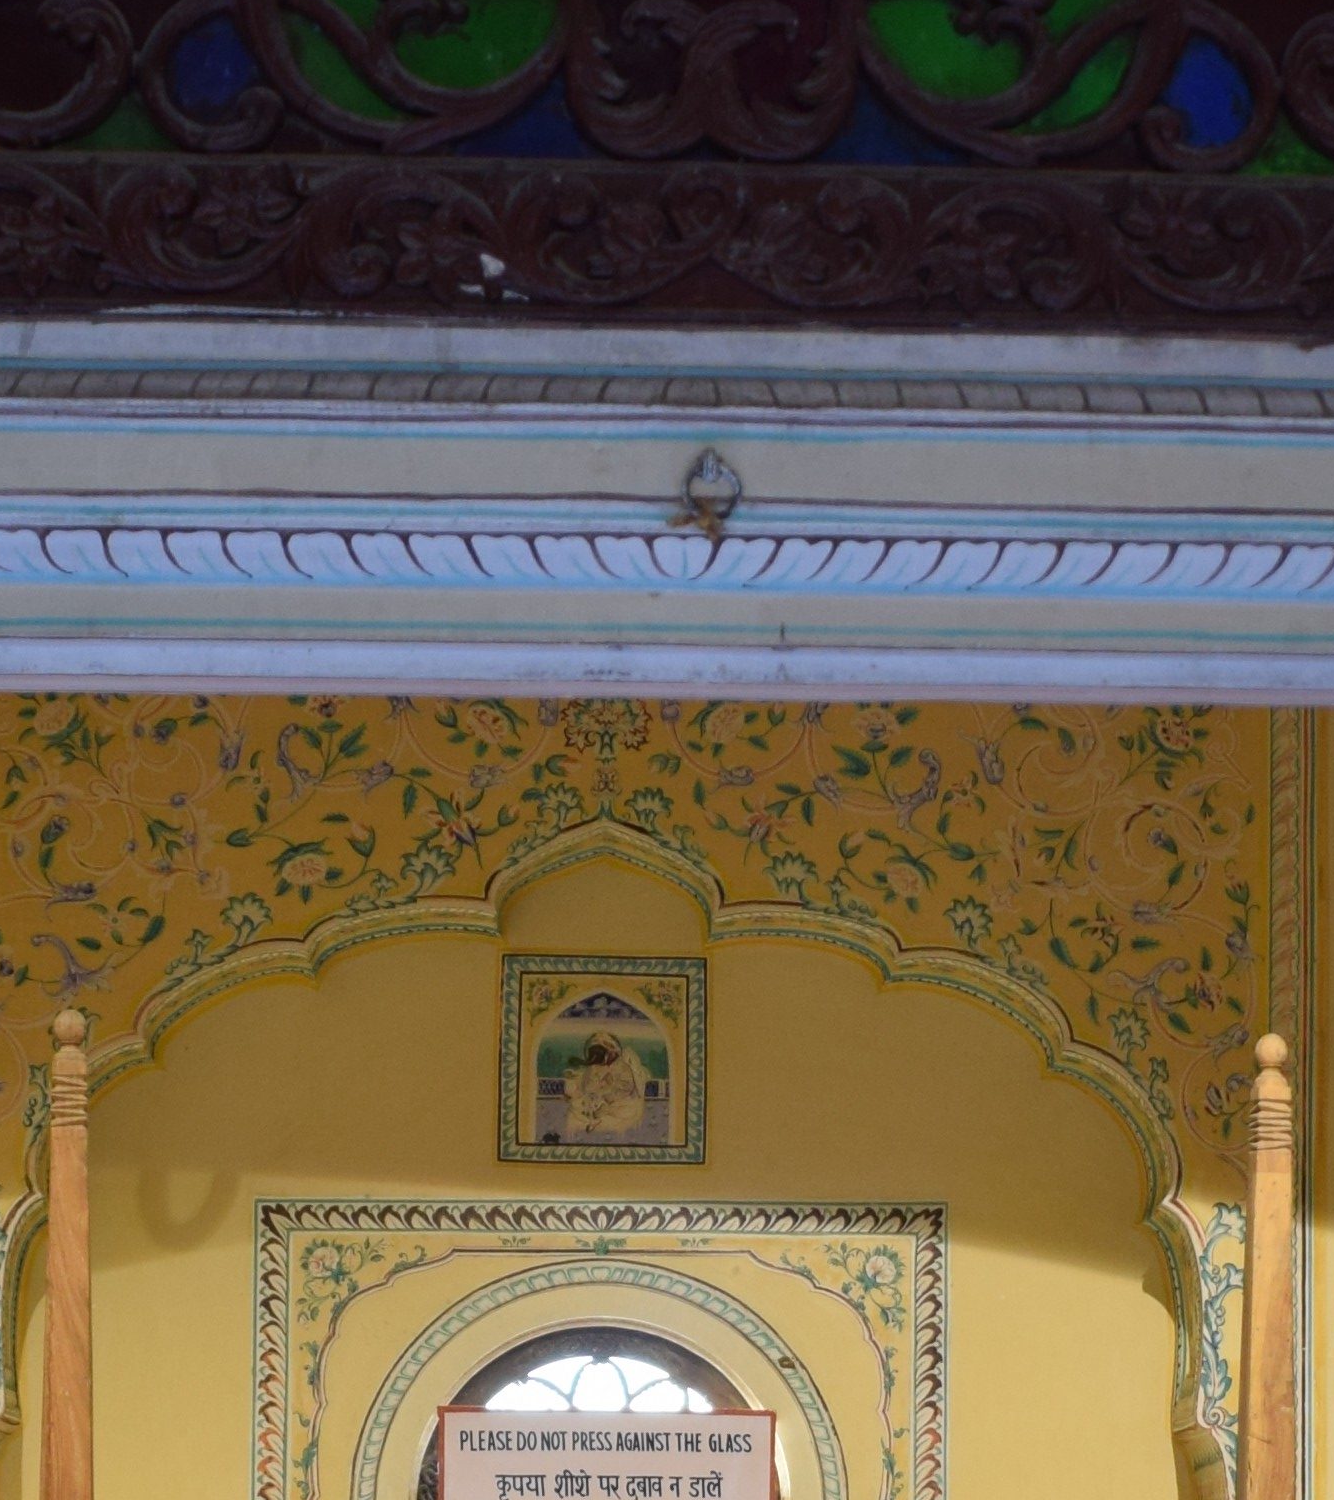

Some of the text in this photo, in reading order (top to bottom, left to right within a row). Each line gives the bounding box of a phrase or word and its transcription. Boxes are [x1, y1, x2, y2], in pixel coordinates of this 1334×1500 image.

[460, 1430, 752, 1453] PLEASE DO NOT PRESS AGAINST THE GLASS
[554, 1469, 592, 1499] शीशे
[597, 1475, 620, 1499] पर
[626, 1476, 663, 1500] दबाव
[669, 1476, 683, 1497] न
[689, 1471, 723, 1498] डालें
